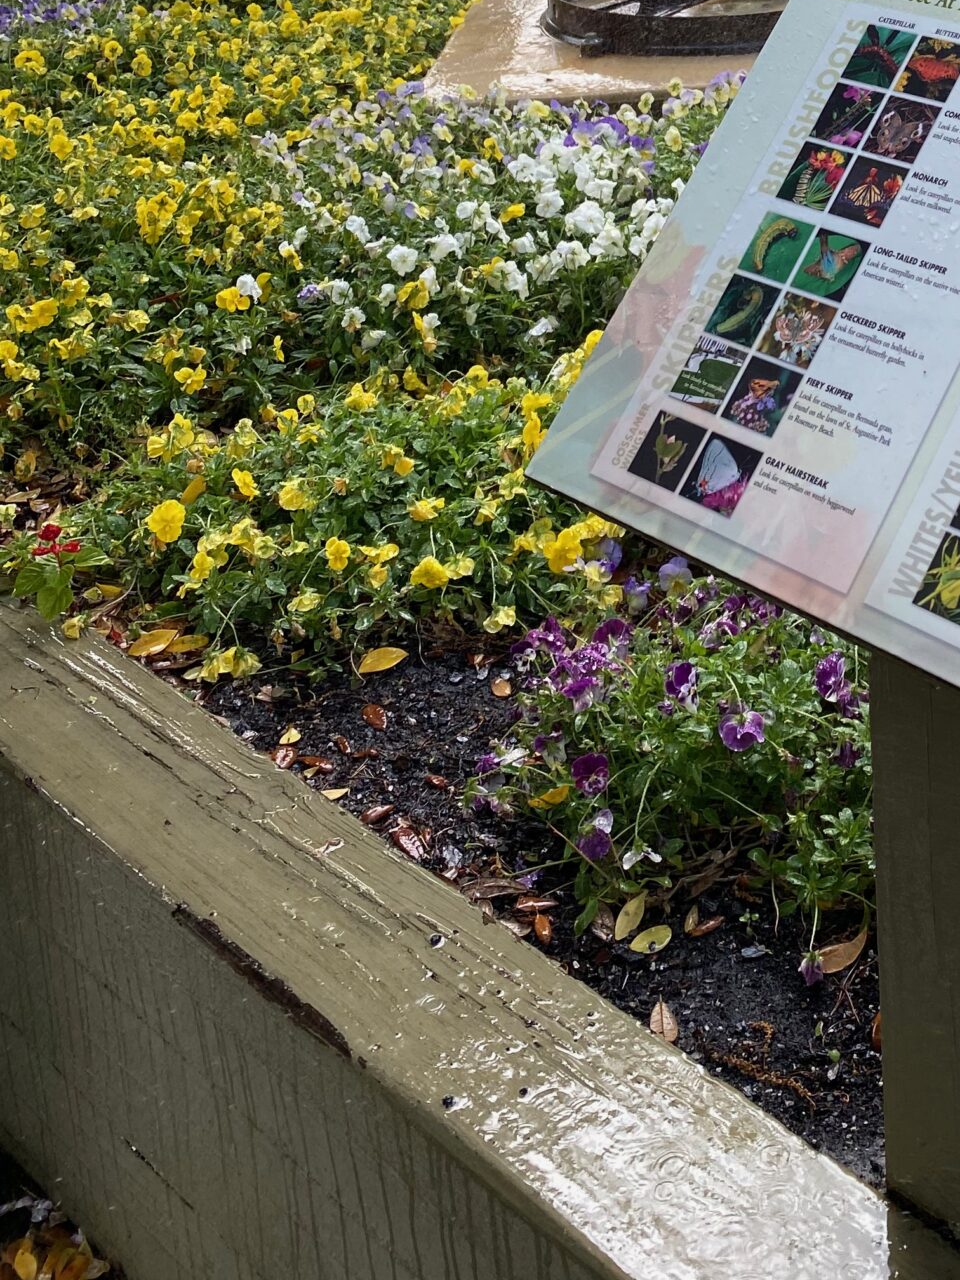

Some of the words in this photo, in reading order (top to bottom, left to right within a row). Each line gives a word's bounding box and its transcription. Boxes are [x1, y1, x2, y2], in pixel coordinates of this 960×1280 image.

[878, 16, 916, 29] CATERPILLAR
[756, 17, 869, 198] BRUSHFOOTS
[937, 121, 951, 131] Look
[951, 125, 960, 133] for
[911, 171, 948, 187] MONARCH
[905, 183, 919, 193] Look
[918, 187, 927, 196] for
[927, 191, 954, 203] caterpillars
[873, 246, 918, 265] LONG-TAILED
[918, 260, 948, 275] SKIPPER
[861, 269, 885, 282] American
[866, 258, 880, 269] Look
[880, 262, 889, 271] for
[888, 267, 915, 280] caterpillars
[923, 277, 933, 286] the
[932, 281, 949, 291] native
[649, 252, 741, 395] SKIPPERS
[834, 322, 848, 333] Look
[847, 326, 856, 336] for
[855, 332, 883, 345] caterpillars
[882, 341, 891, 349] on
[840, 311, 877, 329] CHECKERED
[877, 324, 906, 340] SKIPPER
[828, 333, 838, 342] the
[837, 338, 867, 352] ornamental
[865, 345, 887, 360] butterfly
[806, 377, 825, 389] FIERY
[825, 384, 853, 401] SKIPPER
[798, 390, 813, 402] Look
[812, 395, 821, 405] for
[820, 401, 847, 415] caterpillars
[847, 411, 856, 419] on
[609, 401, 652, 468] GOSSAMER
[793, 414, 819, 432] Rosemary
[793, 401, 810, 414] found
[816, 411, 825, 421] the
[825, 413, 838, 425] lawn
[837, 420, 846, 428] of
[853, 425, 878, 442] Augustine
[878, 435, 891, 447] Park
[617, 428, 648, 473] WINGS
[753, 480, 764, 489] and
[758, 468, 772, 479] Look
[771, 473, 780, 483] for
[765, 456, 785, 470] GRAY
[785, 465, 829, 489] HAIRSTREAK
